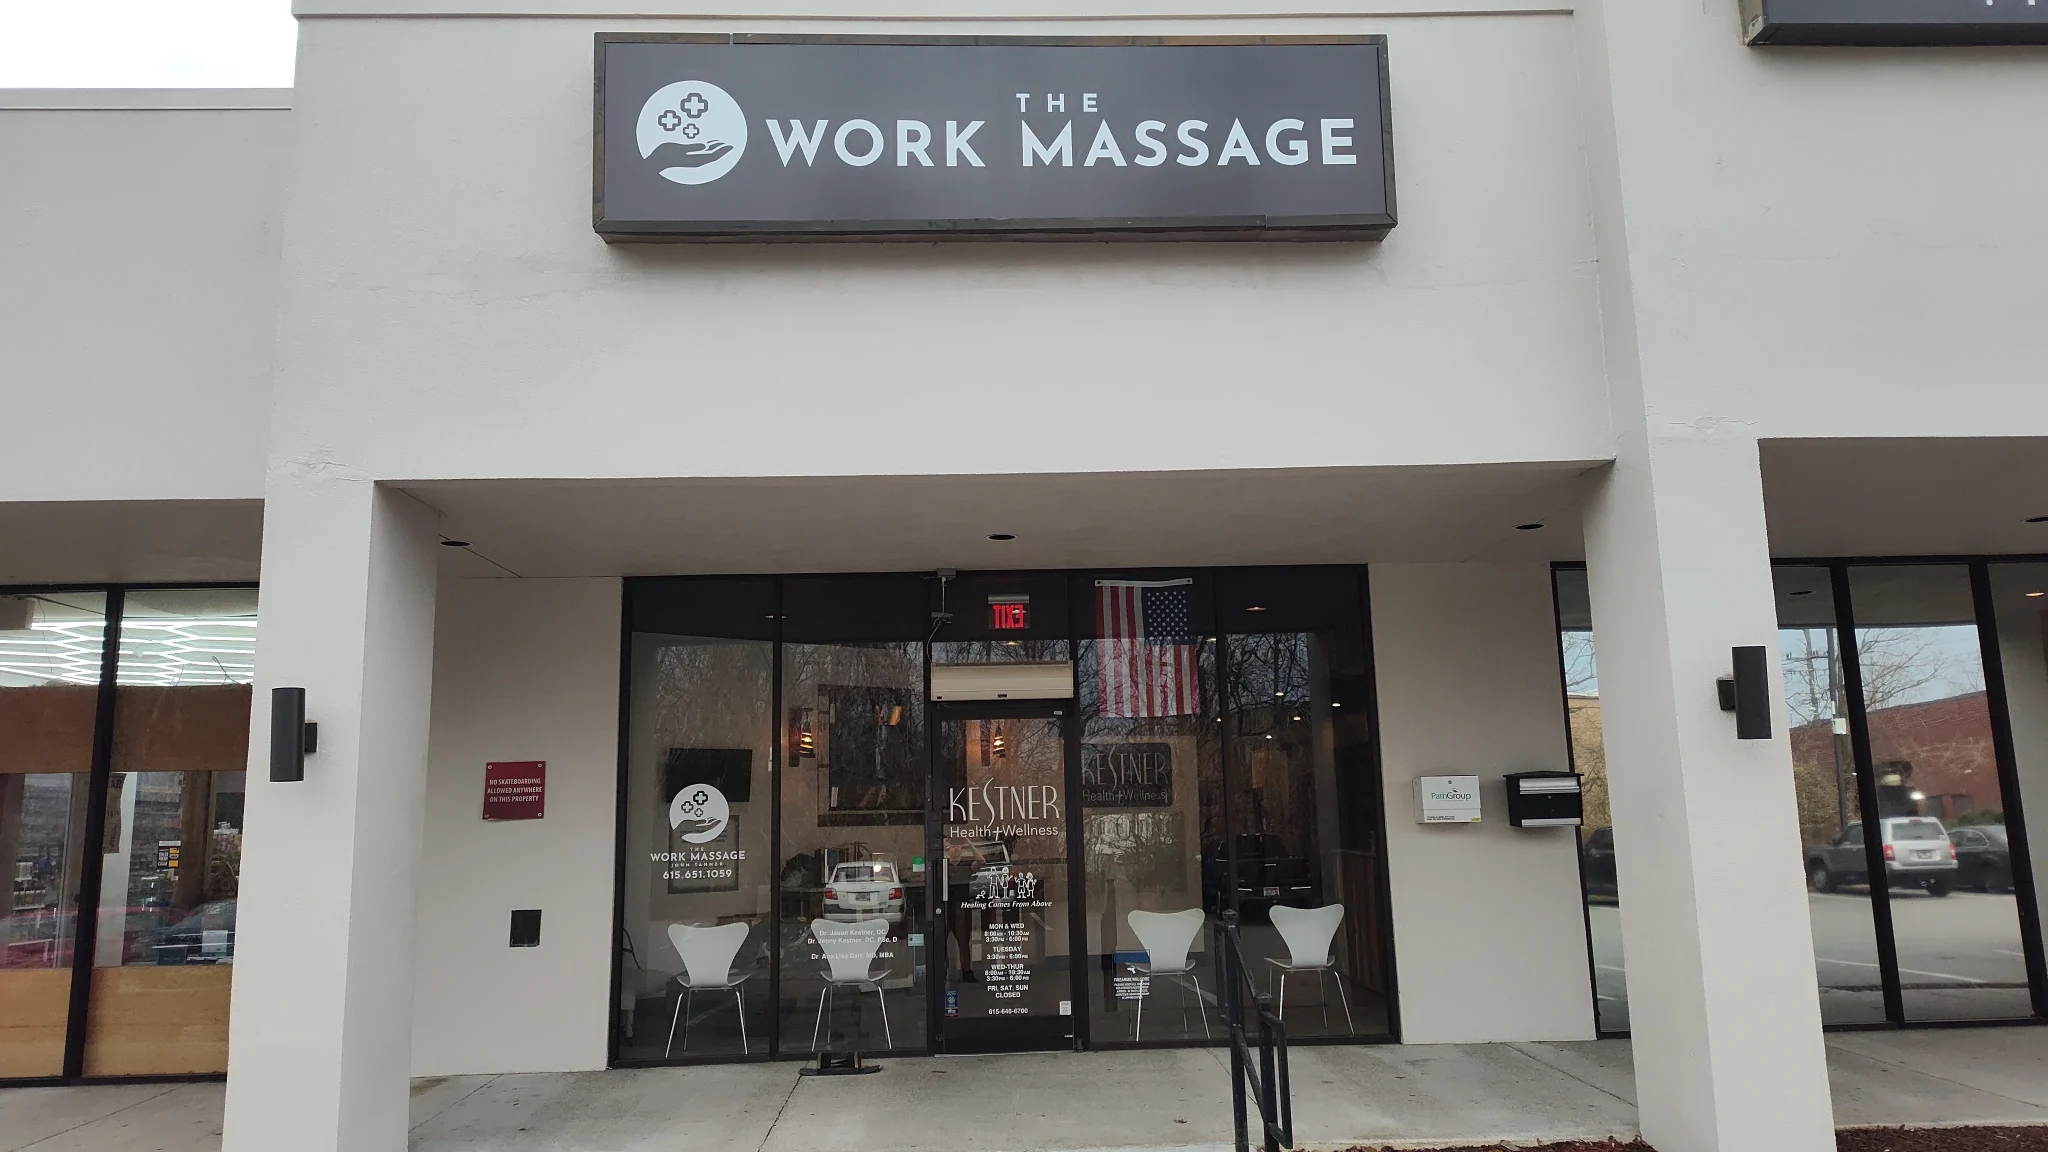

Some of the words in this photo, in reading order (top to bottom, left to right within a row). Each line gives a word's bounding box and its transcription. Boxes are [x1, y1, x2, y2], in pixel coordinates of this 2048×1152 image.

[1016, 93, 1097, 112] THE
[766, 119, 985, 167] WORK
[1022, 118, 1356, 166] MASSAGE
[1081, 745, 1169, 792] KESTNER
[950, 777, 1060, 829] KESTNER
[1431, 792, 1472, 801] PathGroup
[650, 852, 686, 862] WORK
[690, 850, 746, 861] MASSAGE
[662, 869, 732, 880] 615.651.1059
[960, 901, 987, 910] Healing
[1012, 900, 1030, 908] From
